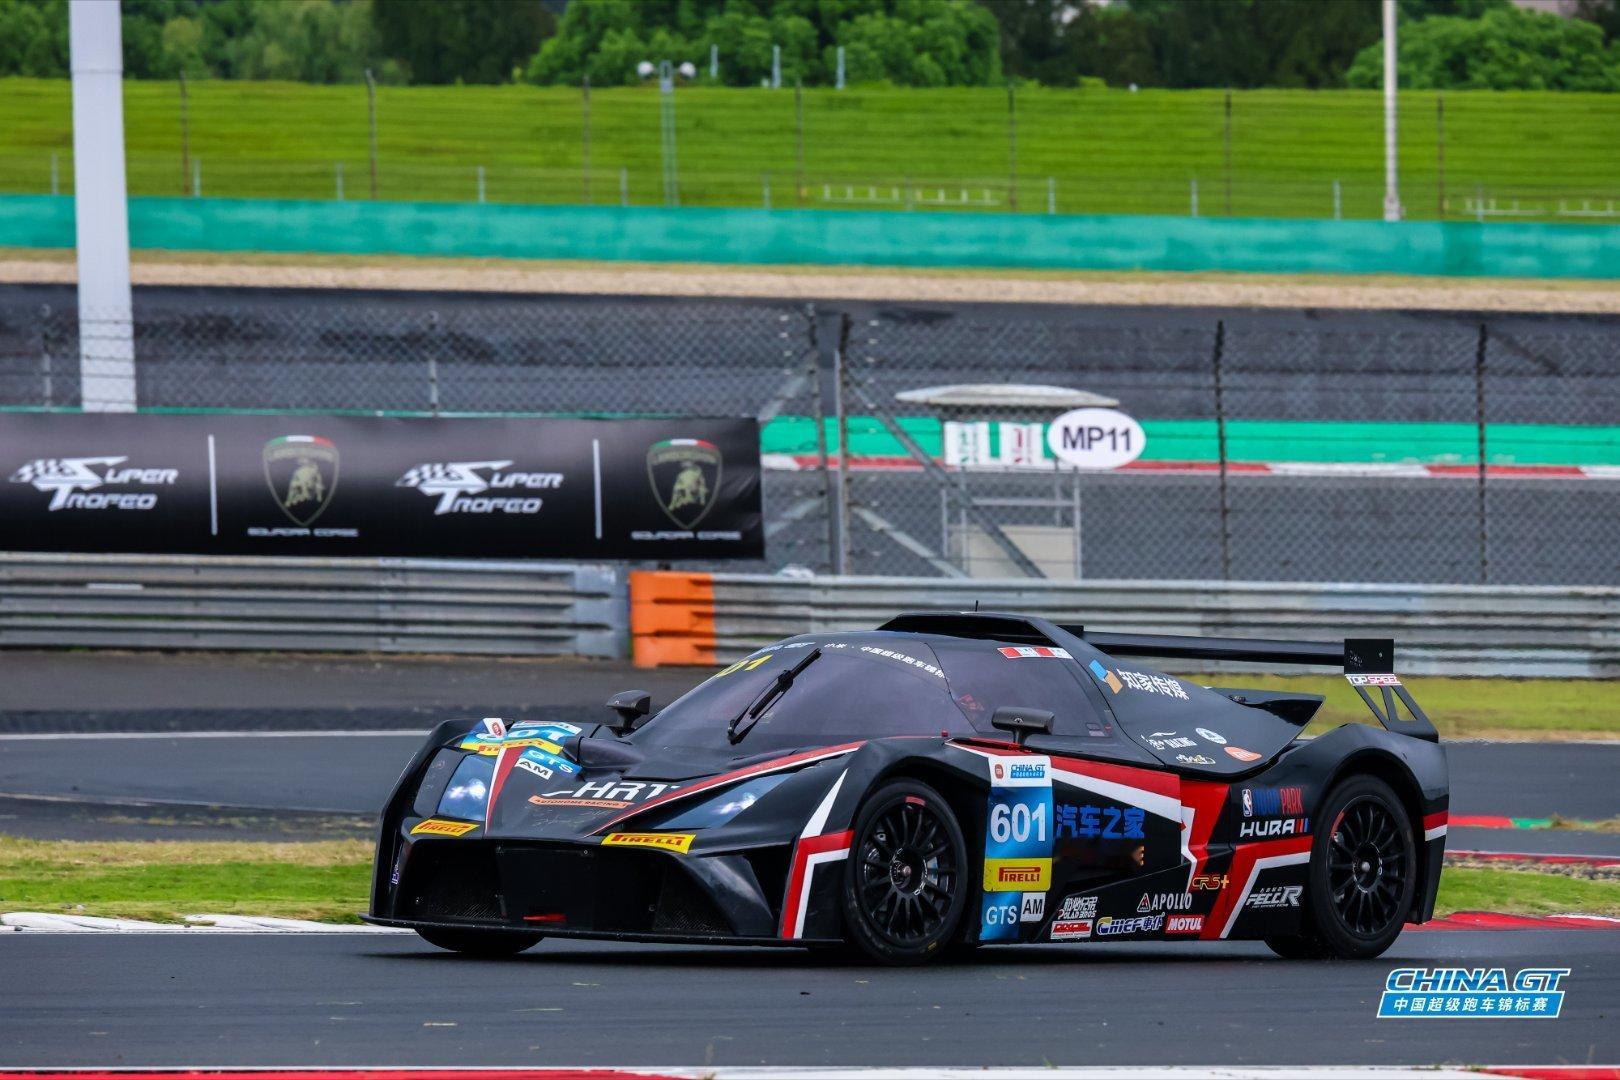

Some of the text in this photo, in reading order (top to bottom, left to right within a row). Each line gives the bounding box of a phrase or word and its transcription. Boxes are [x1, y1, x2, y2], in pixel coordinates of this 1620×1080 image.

[1062, 427, 1131, 450] MP11
[48, 484, 157, 511] TROFEO
[434, 488, 543, 515] TROFEO
[519, 761, 550, 776] AM
[528, 749, 574, 774] GTS
[1011, 764, 1046, 772] CHINA GT
[418, 821, 470, 833] PIRELLI
[990, 802, 1046, 843] 601
[1056, 804, 1145, 839] 汽车之家
[611, 834, 685, 846] PIRELLI
[998, 866, 1041, 882] PIRELLI
[1151, 892, 1193, 911] APOLLO
[985, 905, 1017, 925] GTS
[1022, 898, 1043, 915] AM
[1097, 917, 1143, 935] CHIEF
[1167, 917, 1202, 931] MOTUL
